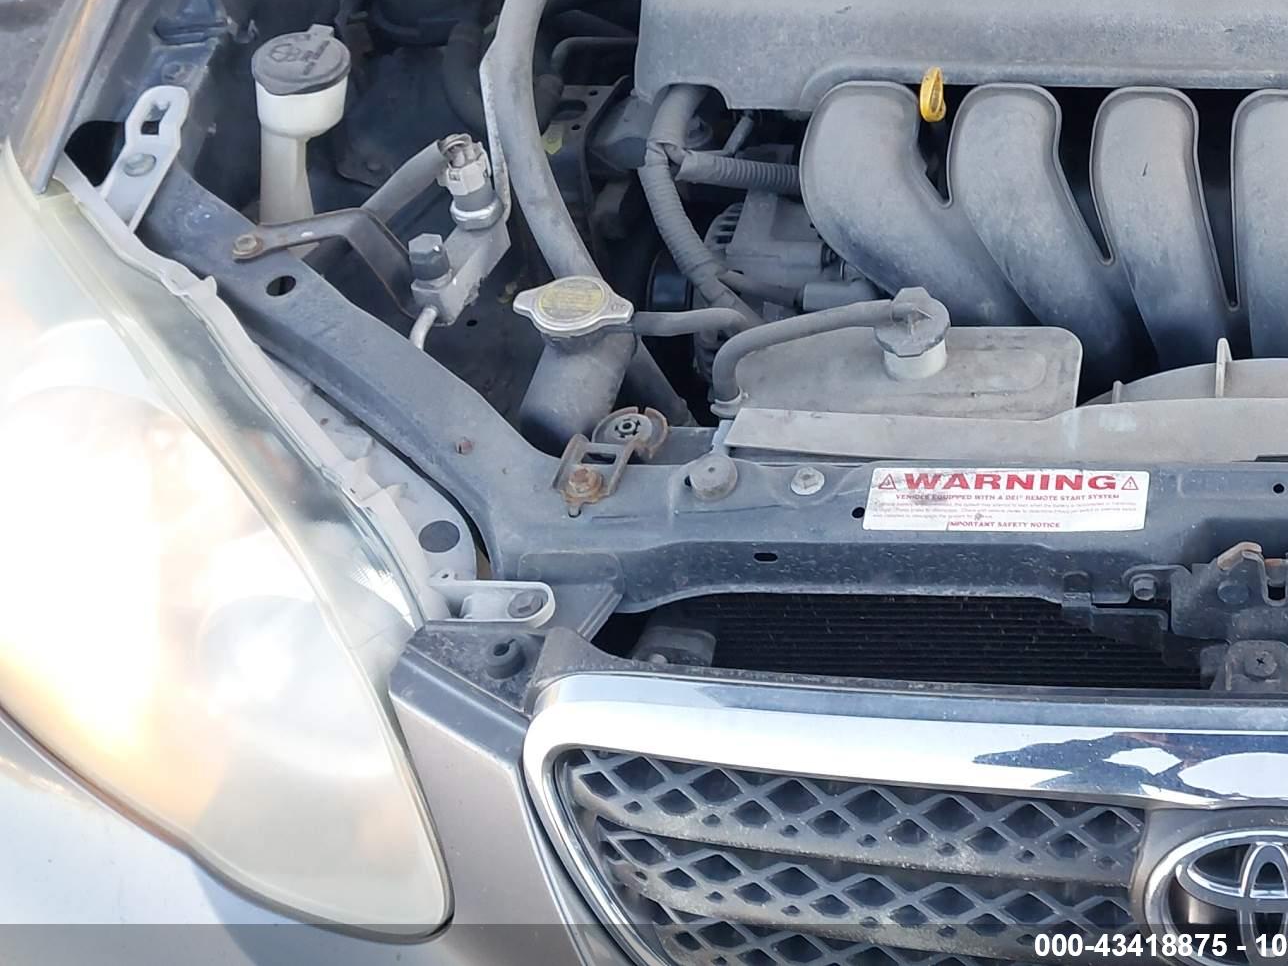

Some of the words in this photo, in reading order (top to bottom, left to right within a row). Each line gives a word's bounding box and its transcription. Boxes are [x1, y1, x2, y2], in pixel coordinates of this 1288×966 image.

[904, 472, 1117, 491] WARNING
[932, 493, 972, 501] EQUIPPED
[948, 520, 995, 528] IMPORTANT
[1030, 521, 1061, 529] NOTICE
